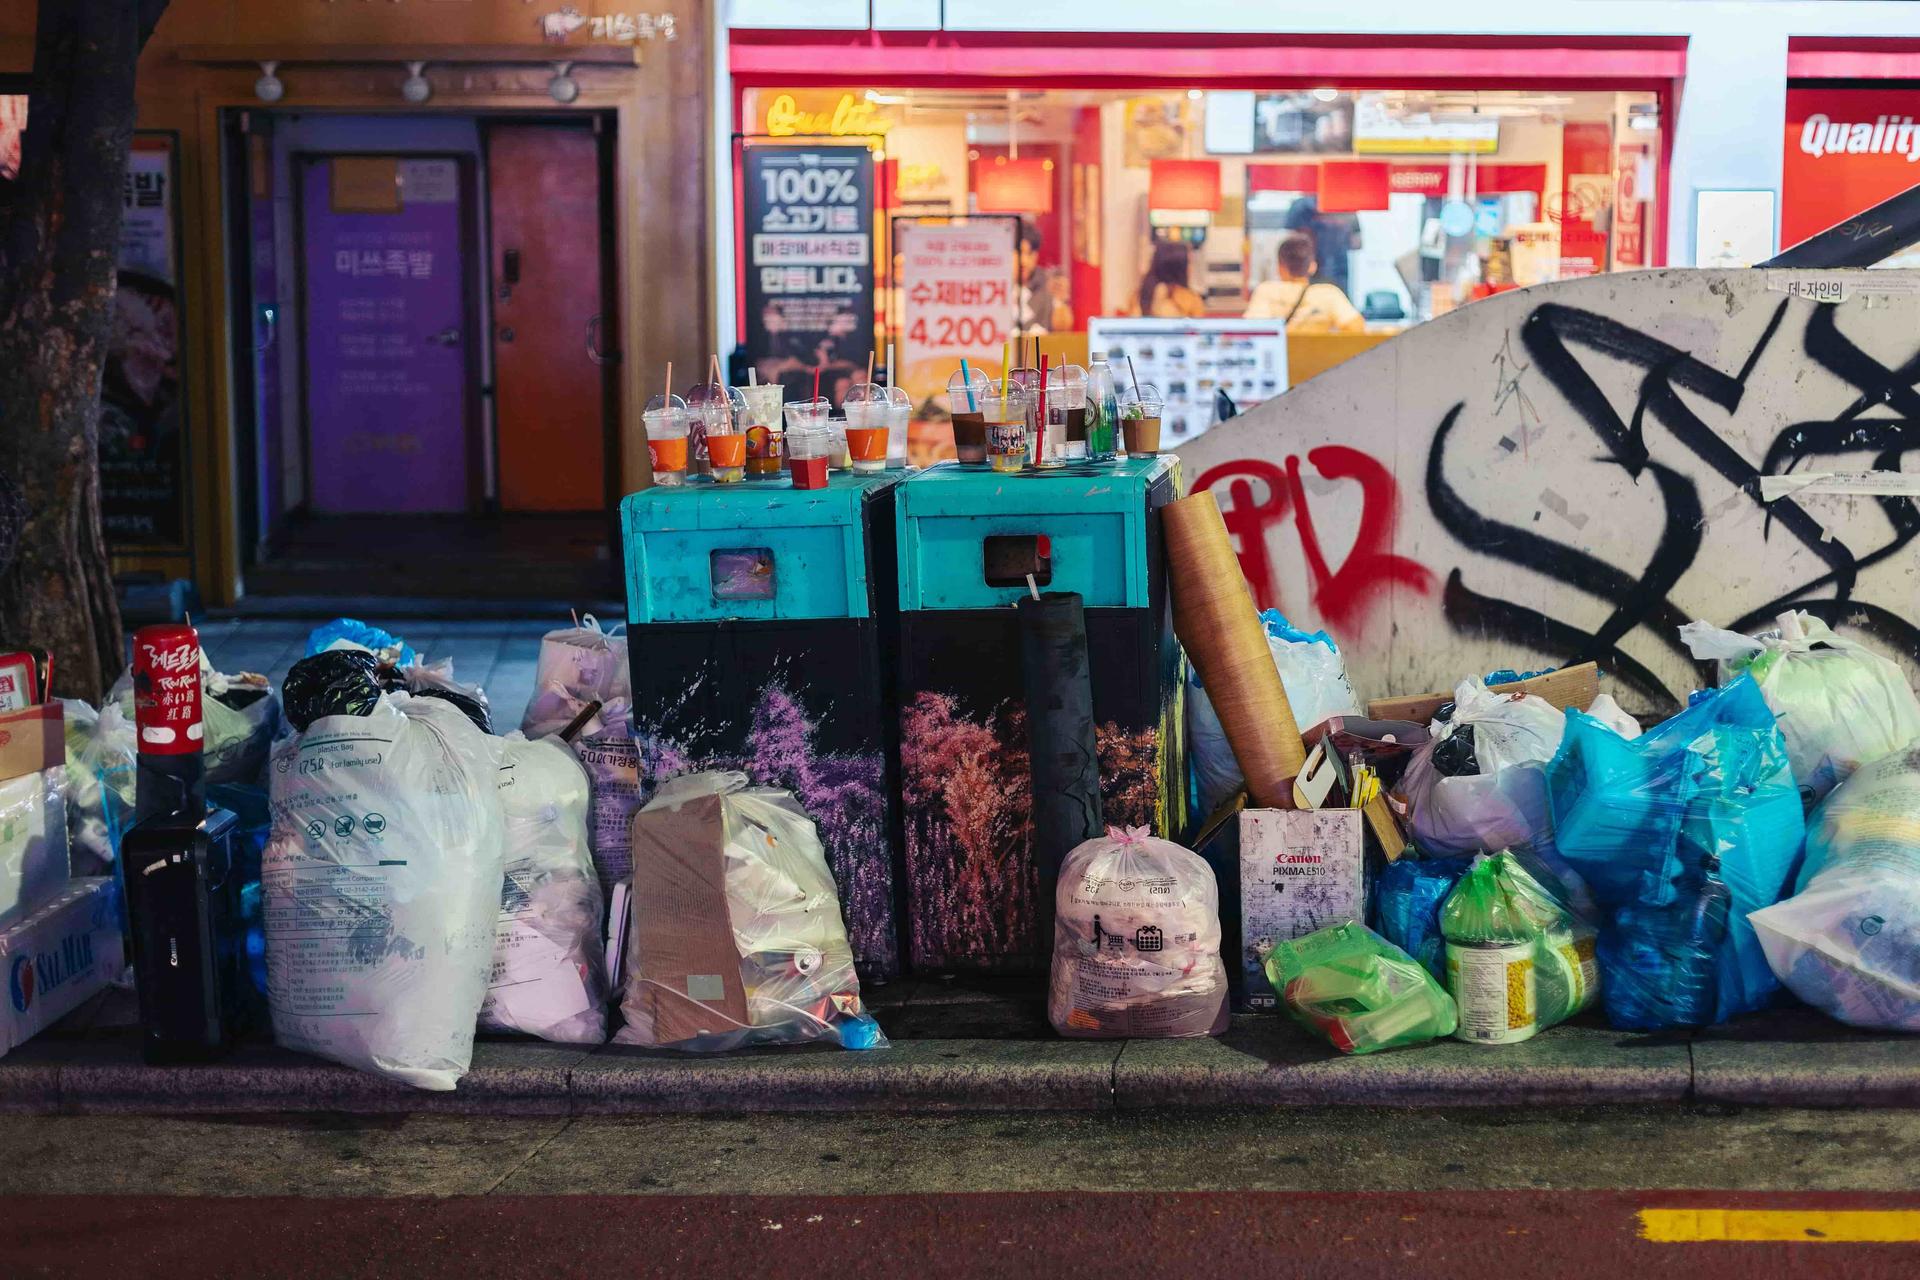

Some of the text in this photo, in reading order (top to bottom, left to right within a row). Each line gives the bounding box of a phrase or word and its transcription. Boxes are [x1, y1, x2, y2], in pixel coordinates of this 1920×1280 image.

[761, 168, 860, 204] 100%
[762, 206, 860, 233] 소고기로
[335, 250, 433, 280] 미쓰족발
[911, 280, 1008, 306] 수제버거
[142, 643, 200, 673] 레드로드
[1273, 867, 1326, 876] PIXMA E510
[1276, 853, 1322, 864] Canon
[170, 937, 178, 966] Canon
